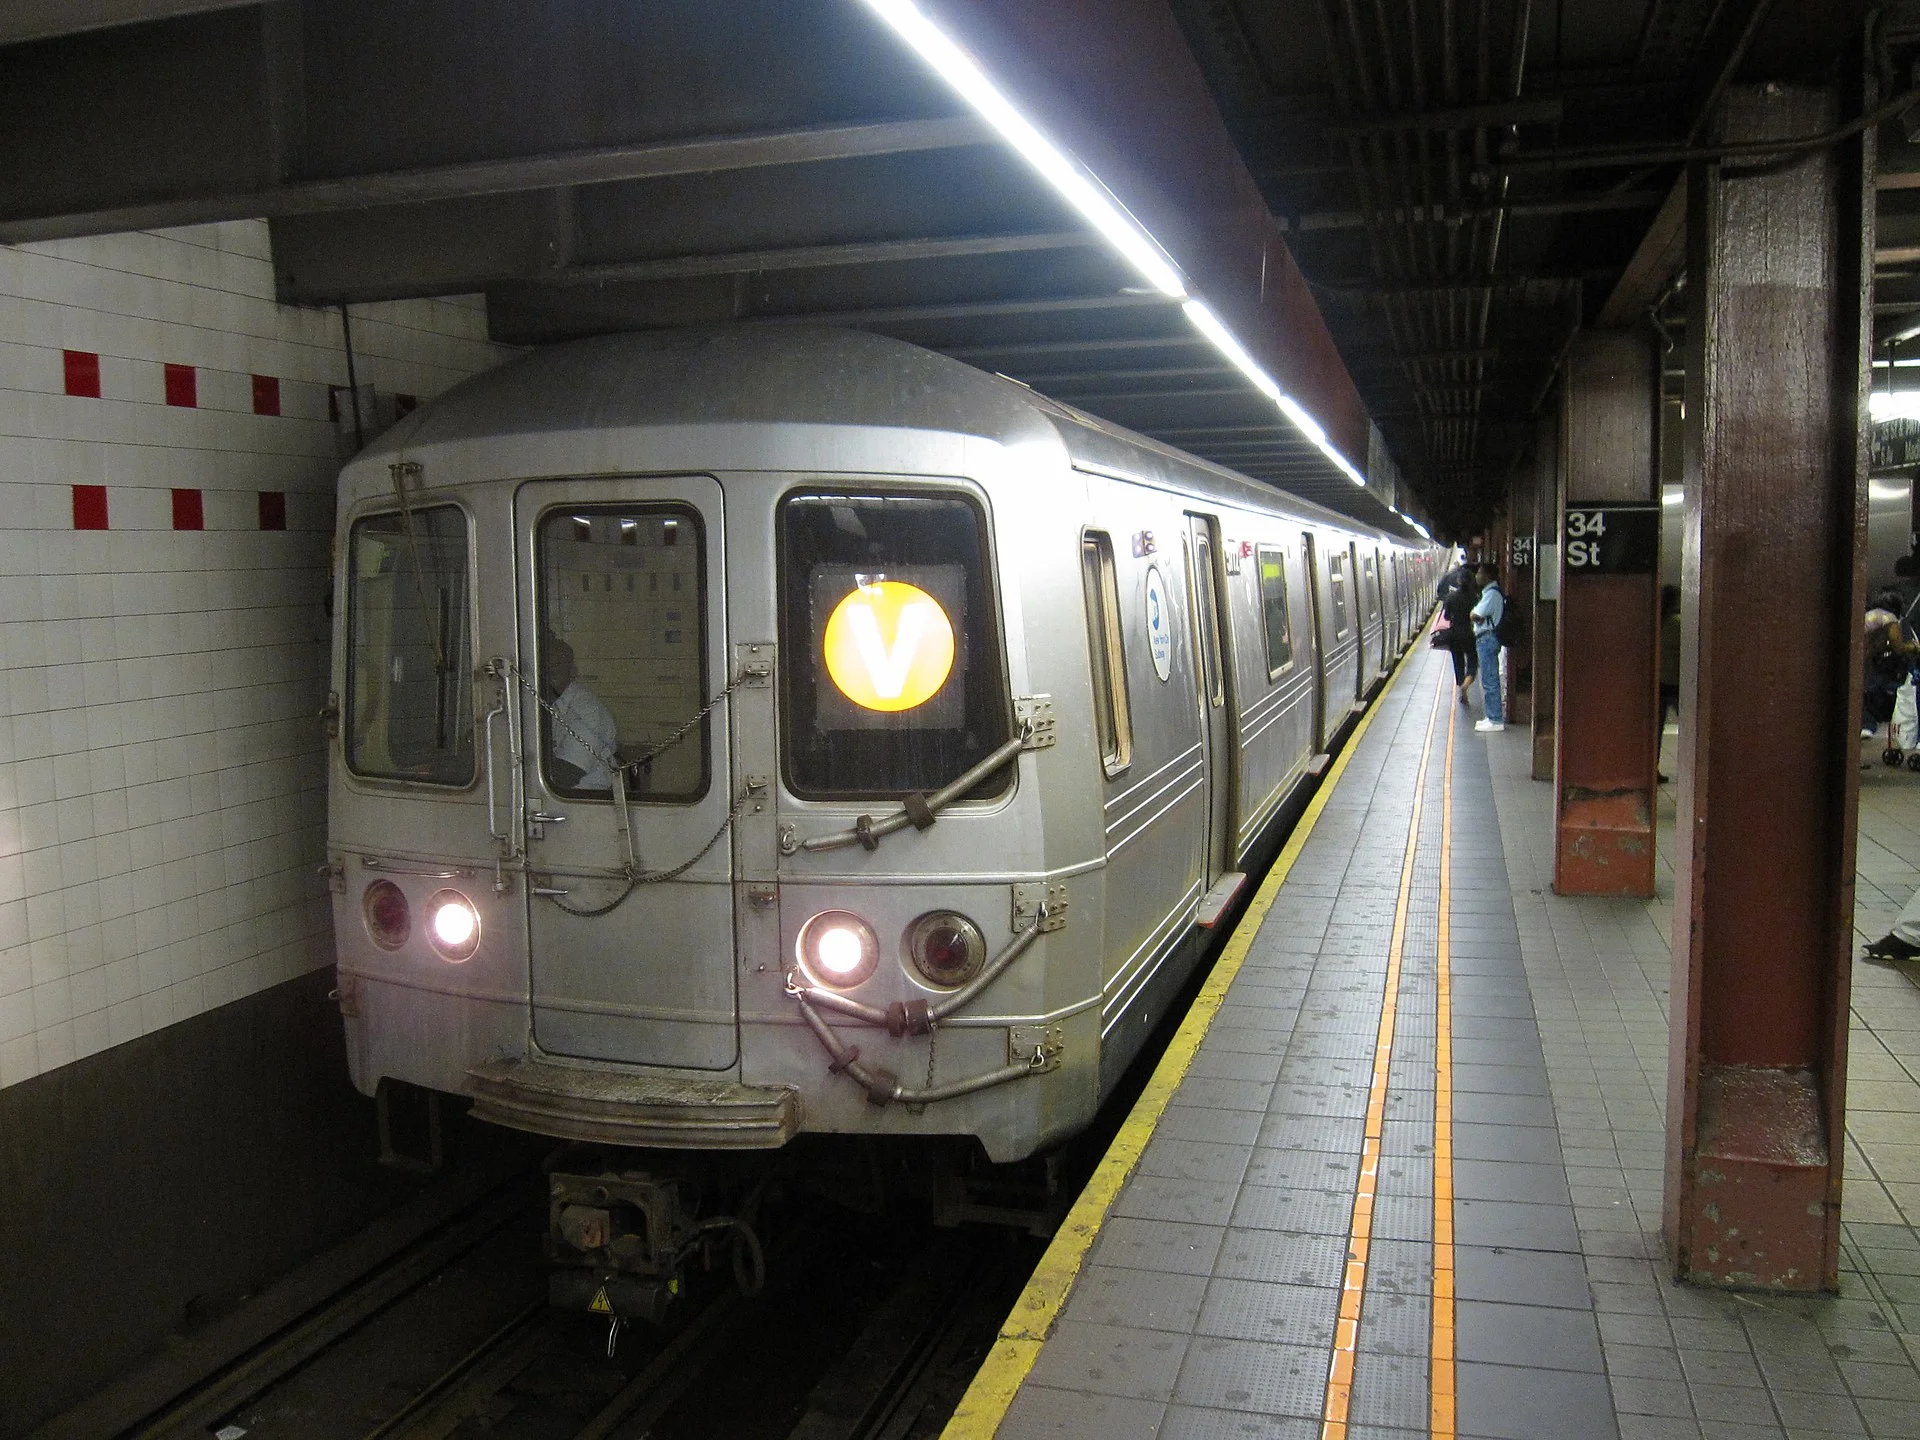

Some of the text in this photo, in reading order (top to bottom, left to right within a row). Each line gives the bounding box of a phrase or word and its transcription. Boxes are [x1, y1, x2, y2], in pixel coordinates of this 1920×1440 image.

[1568, 512, 1607, 537] 34
[1513, 539, 1532, 552] 34
[1567, 541, 1600, 566] St
[1513, 552, 1529, 566] St
[847, 602, 931, 698] V
